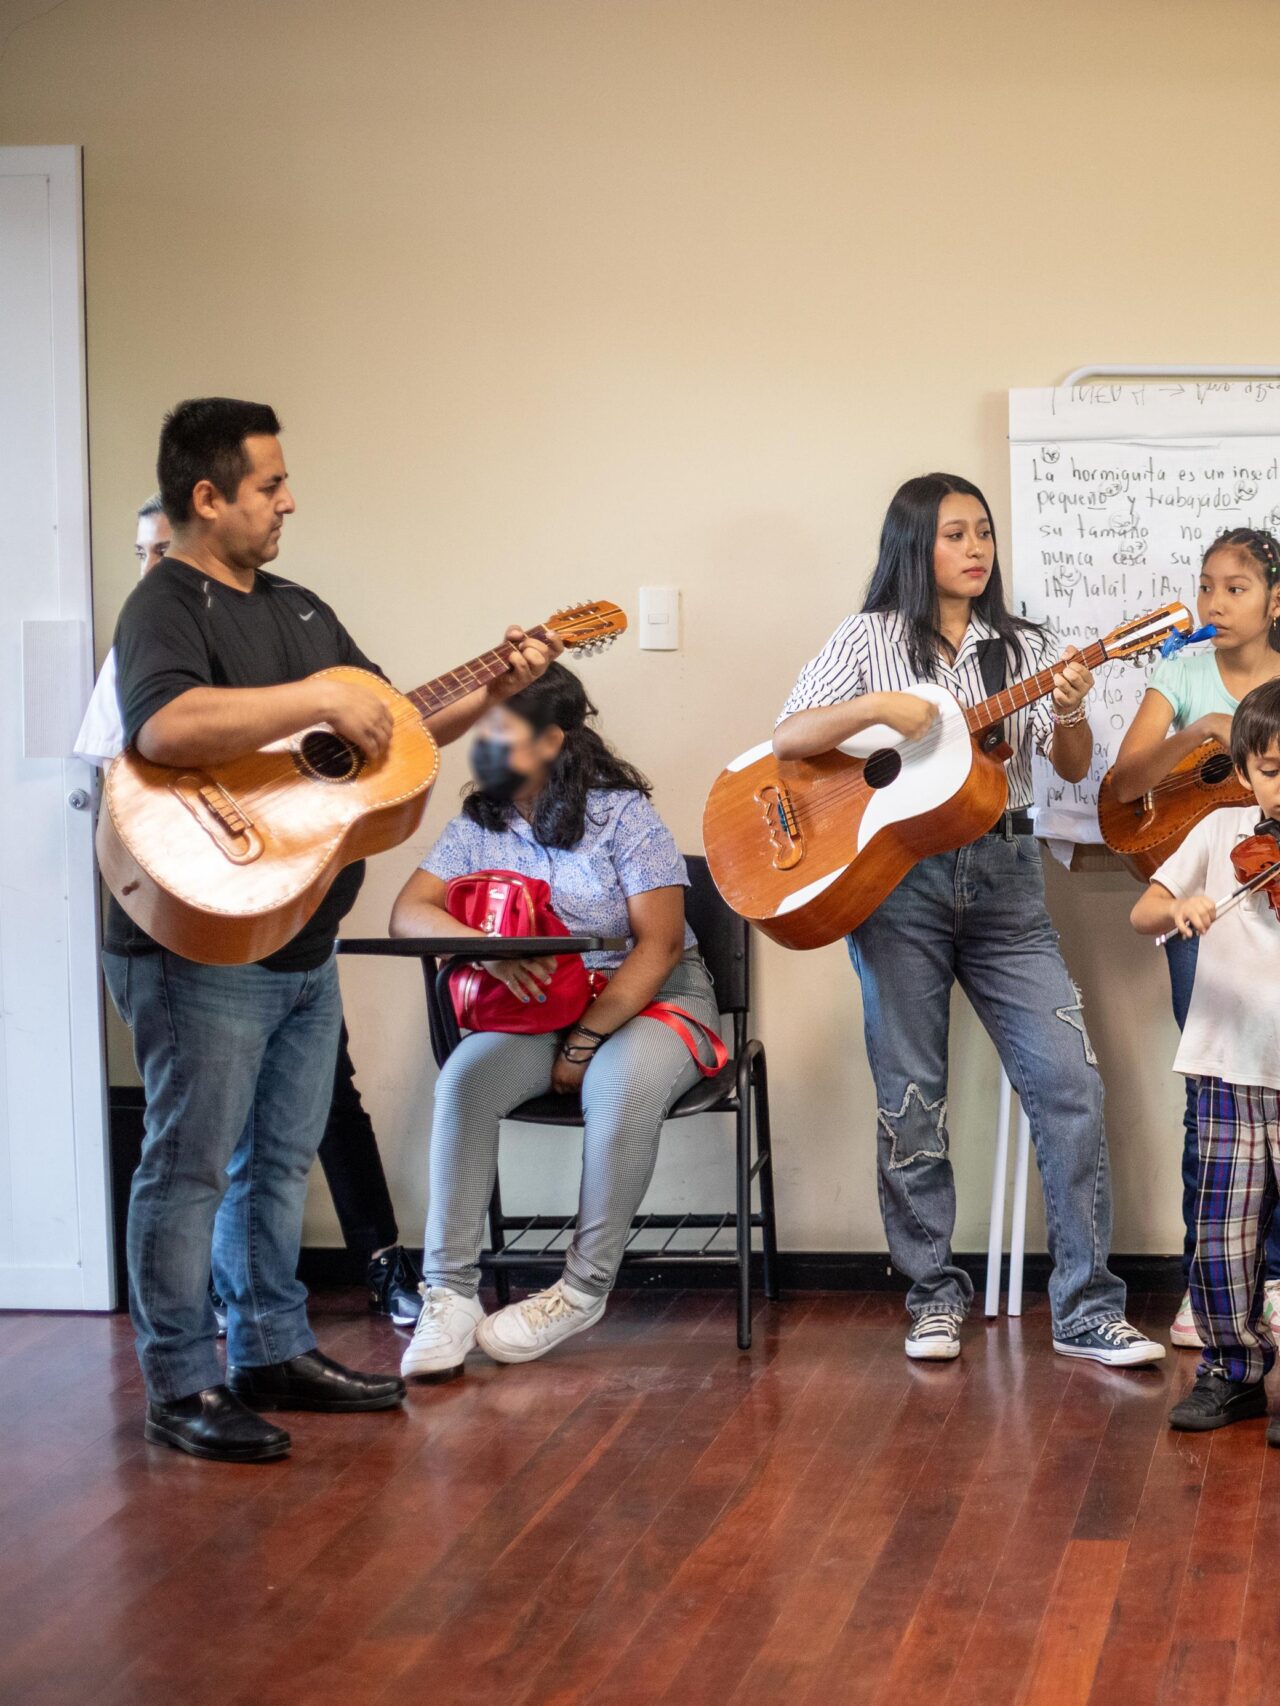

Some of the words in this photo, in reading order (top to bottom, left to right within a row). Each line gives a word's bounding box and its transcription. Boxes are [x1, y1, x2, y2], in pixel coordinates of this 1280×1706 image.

[1033, 458, 1055, 482] La
[1070, 456, 1166, 493] hormiguita
[1178, 469, 1195, 482] es
[1204, 468, 1225, 481] un
[1036, 490, 1107, 514] pequeño
[1126, 494, 1136, 516] y
[1145, 486, 1241, 518] trabajador
[1039, 523, 1063, 537] su
[1180, 525, 1202, 541] no
[1040, 549, 1094, 567] nunca
[1170, 551, 1191, 565] su
[1045, 614, 1099, 640] Nunca
